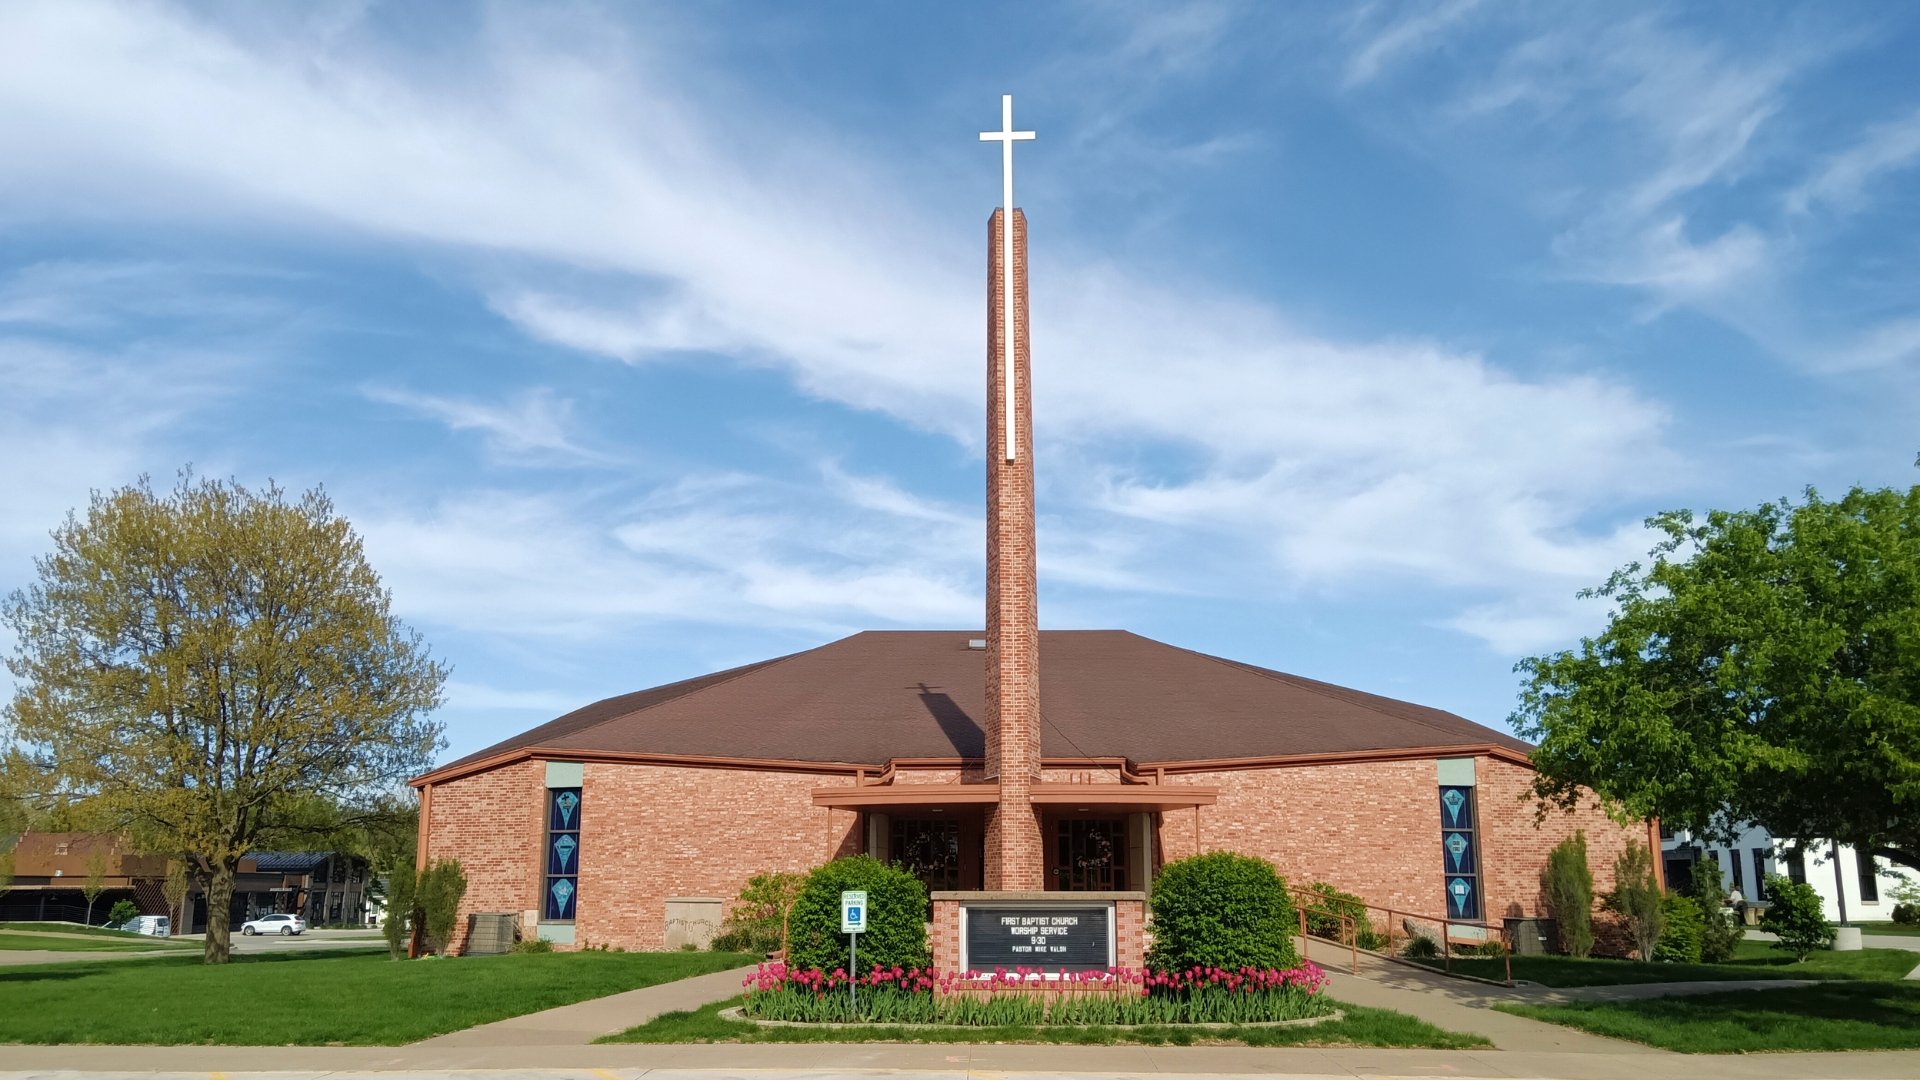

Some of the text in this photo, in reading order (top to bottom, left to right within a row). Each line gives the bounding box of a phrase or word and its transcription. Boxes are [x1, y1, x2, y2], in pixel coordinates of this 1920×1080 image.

[1001, 917, 1078, 925] FIRST BAPTIST CHURCH
[1010, 927, 1068, 935] WORSHIP SERVICE
